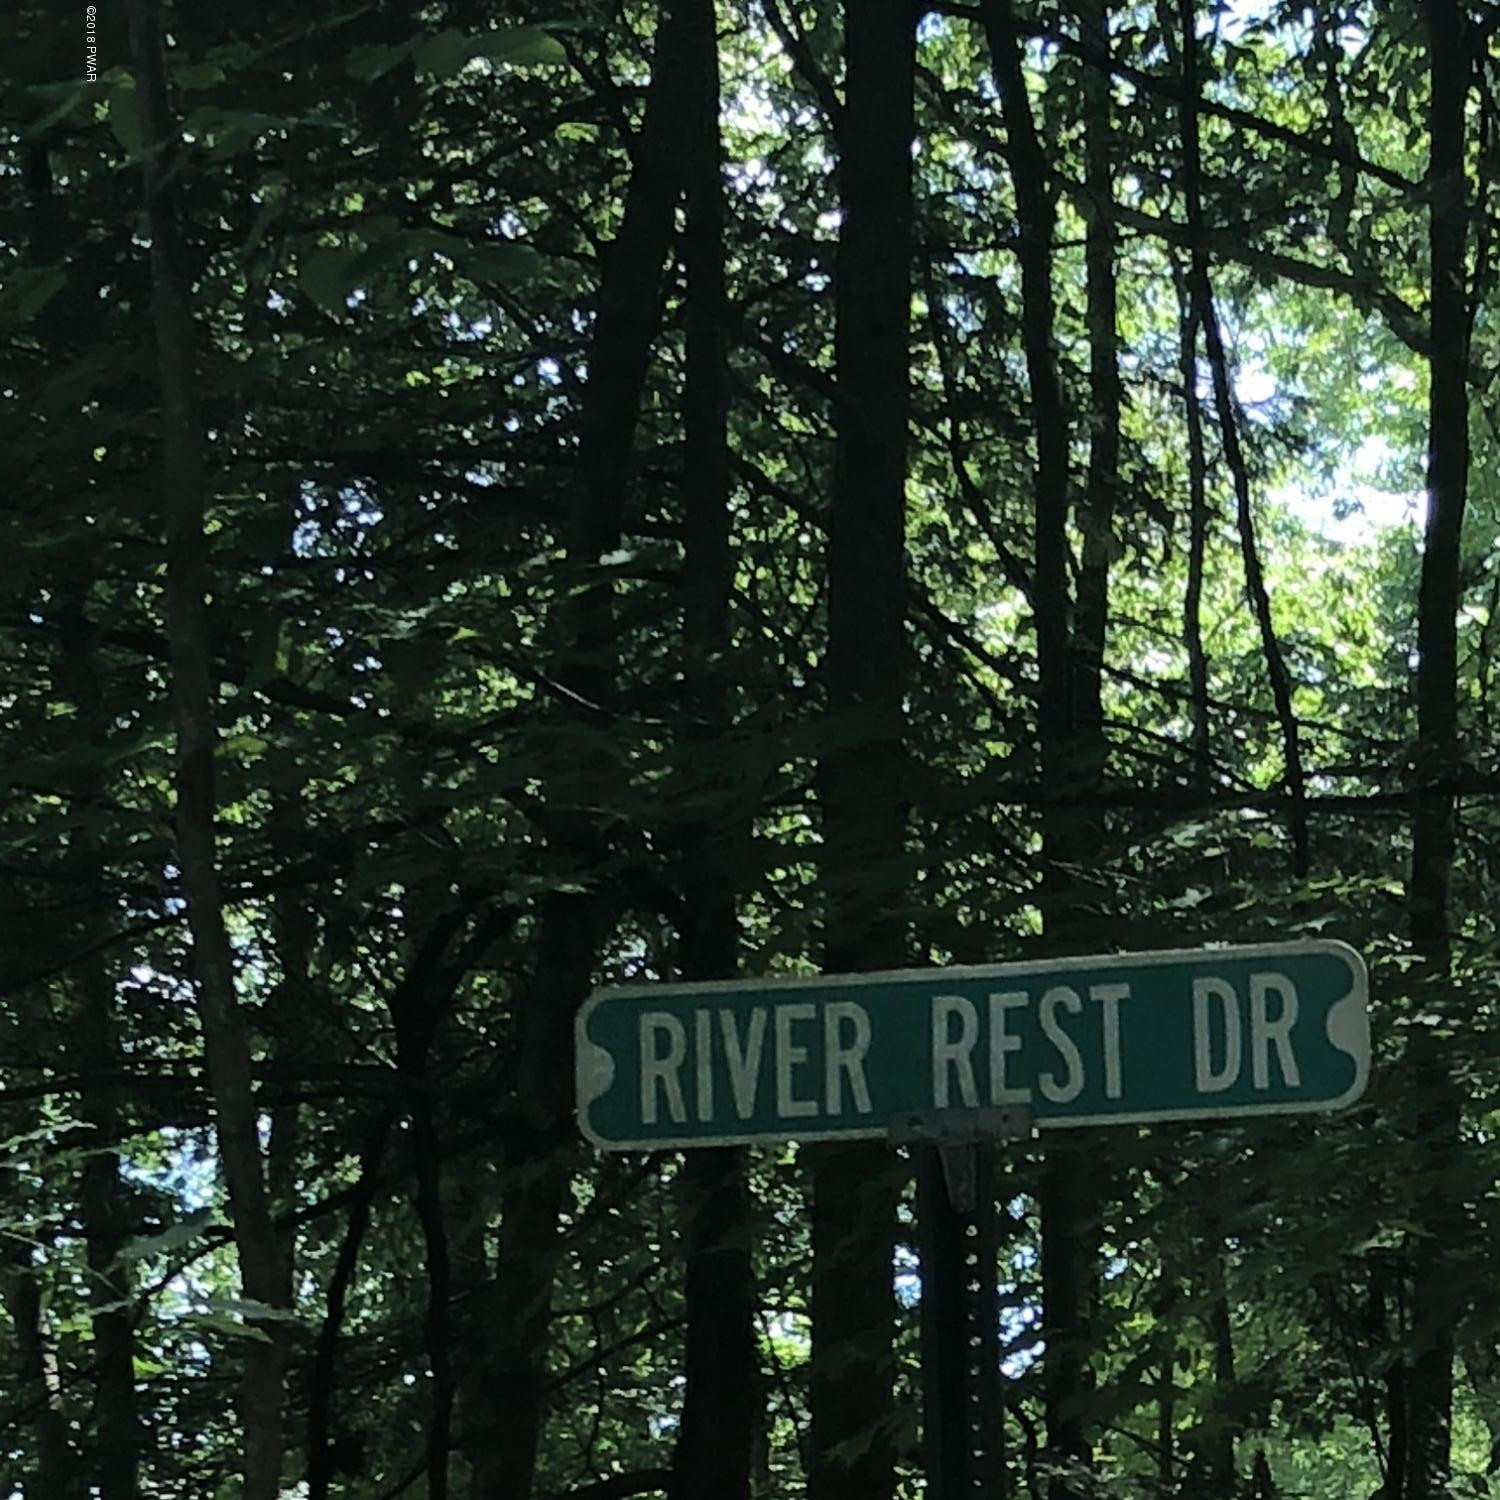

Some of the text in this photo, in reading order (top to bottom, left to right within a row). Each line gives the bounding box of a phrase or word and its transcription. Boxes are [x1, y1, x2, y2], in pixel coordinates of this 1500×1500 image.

[639, 971, 1301, 1124] RIVER REST DR
